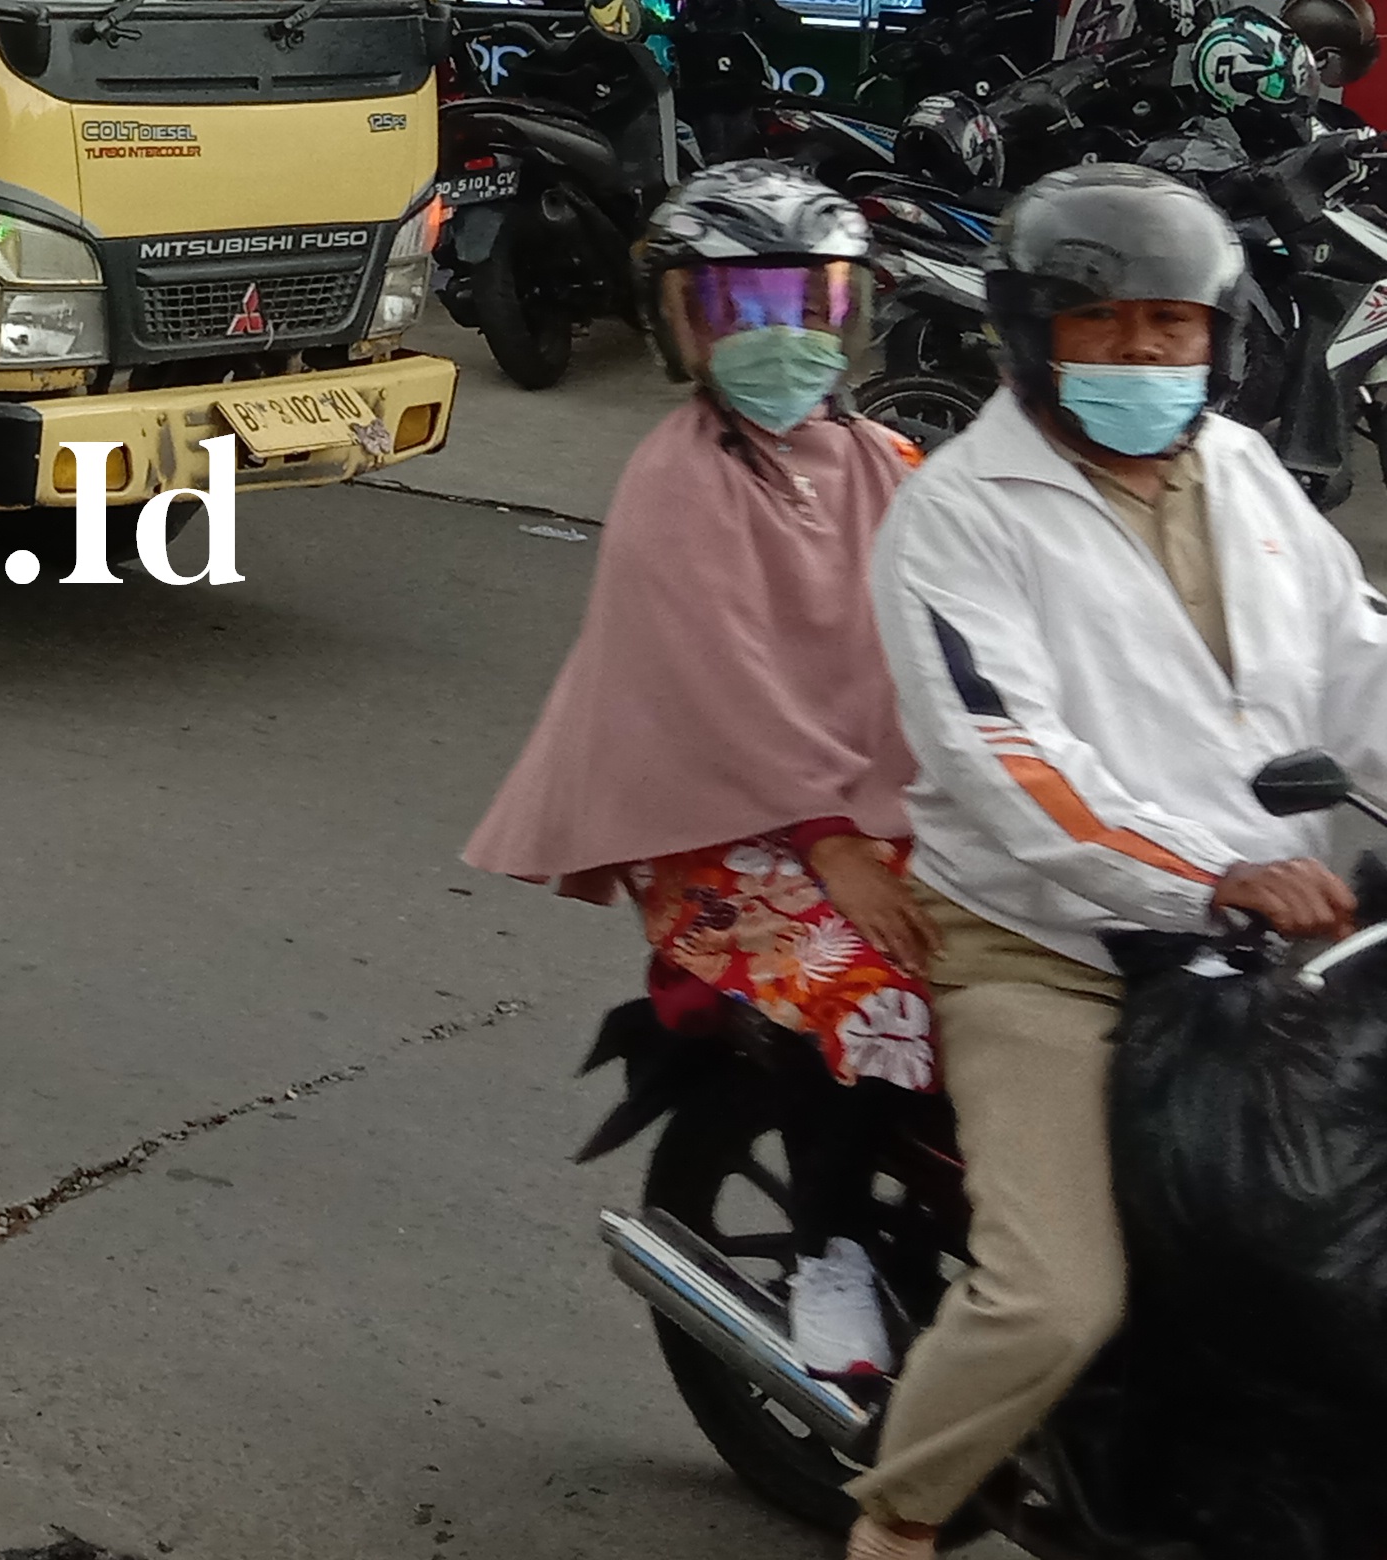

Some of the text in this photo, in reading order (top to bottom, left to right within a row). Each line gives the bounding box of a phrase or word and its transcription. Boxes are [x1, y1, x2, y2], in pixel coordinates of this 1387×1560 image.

[82, 120, 198, 142] COLT DIESEL
[85, 145, 202, 160] TURBO INTERCOOLER
[458, 175, 491, 192] 5101
[497, 171, 516, 185] CV
[140, 230, 368, 260] MITSUBISHI FUSO
